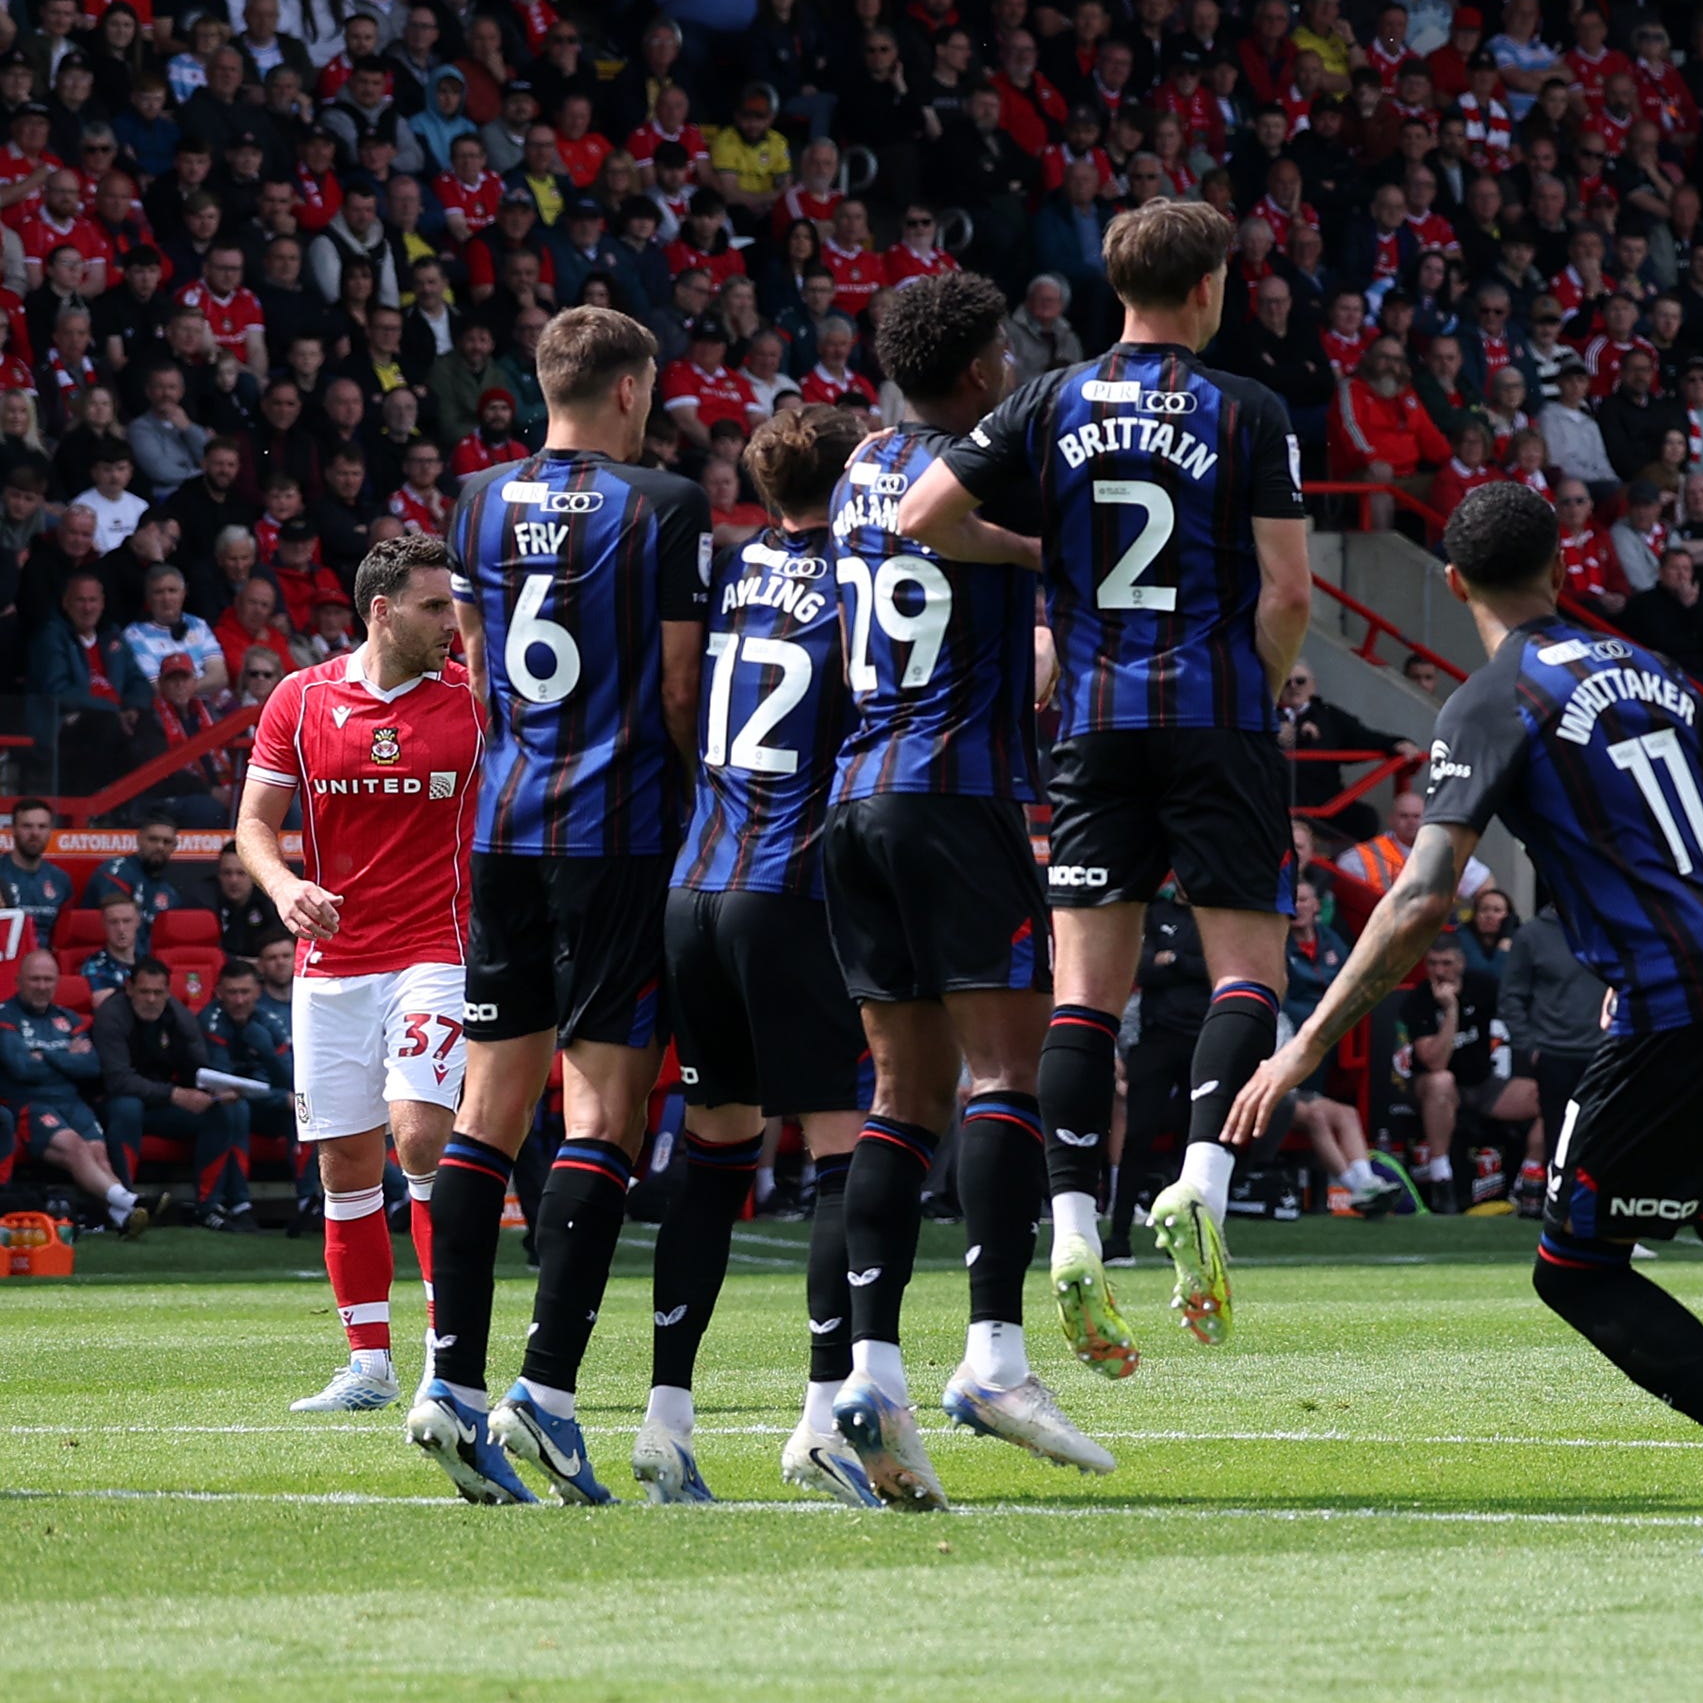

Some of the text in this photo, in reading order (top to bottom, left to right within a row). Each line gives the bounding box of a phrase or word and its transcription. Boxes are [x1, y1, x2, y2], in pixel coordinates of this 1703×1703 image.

[1057, 417, 1218, 480] BRITTAIN
[513, 522, 569, 556] FRY
[1093, 480, 1177, 612] 2
[721, 576, 826, 624] AYLING
[505, 574, 581, 704] 6
[703, 632, 812, 773] 12
[1555, 668, 1695, 746] WHITTAKER
[313, 778, 422, 794] UNITED
[398, 1013, 464, 1061] 37
[1610, 1197, 1699, 1220] NOCO
